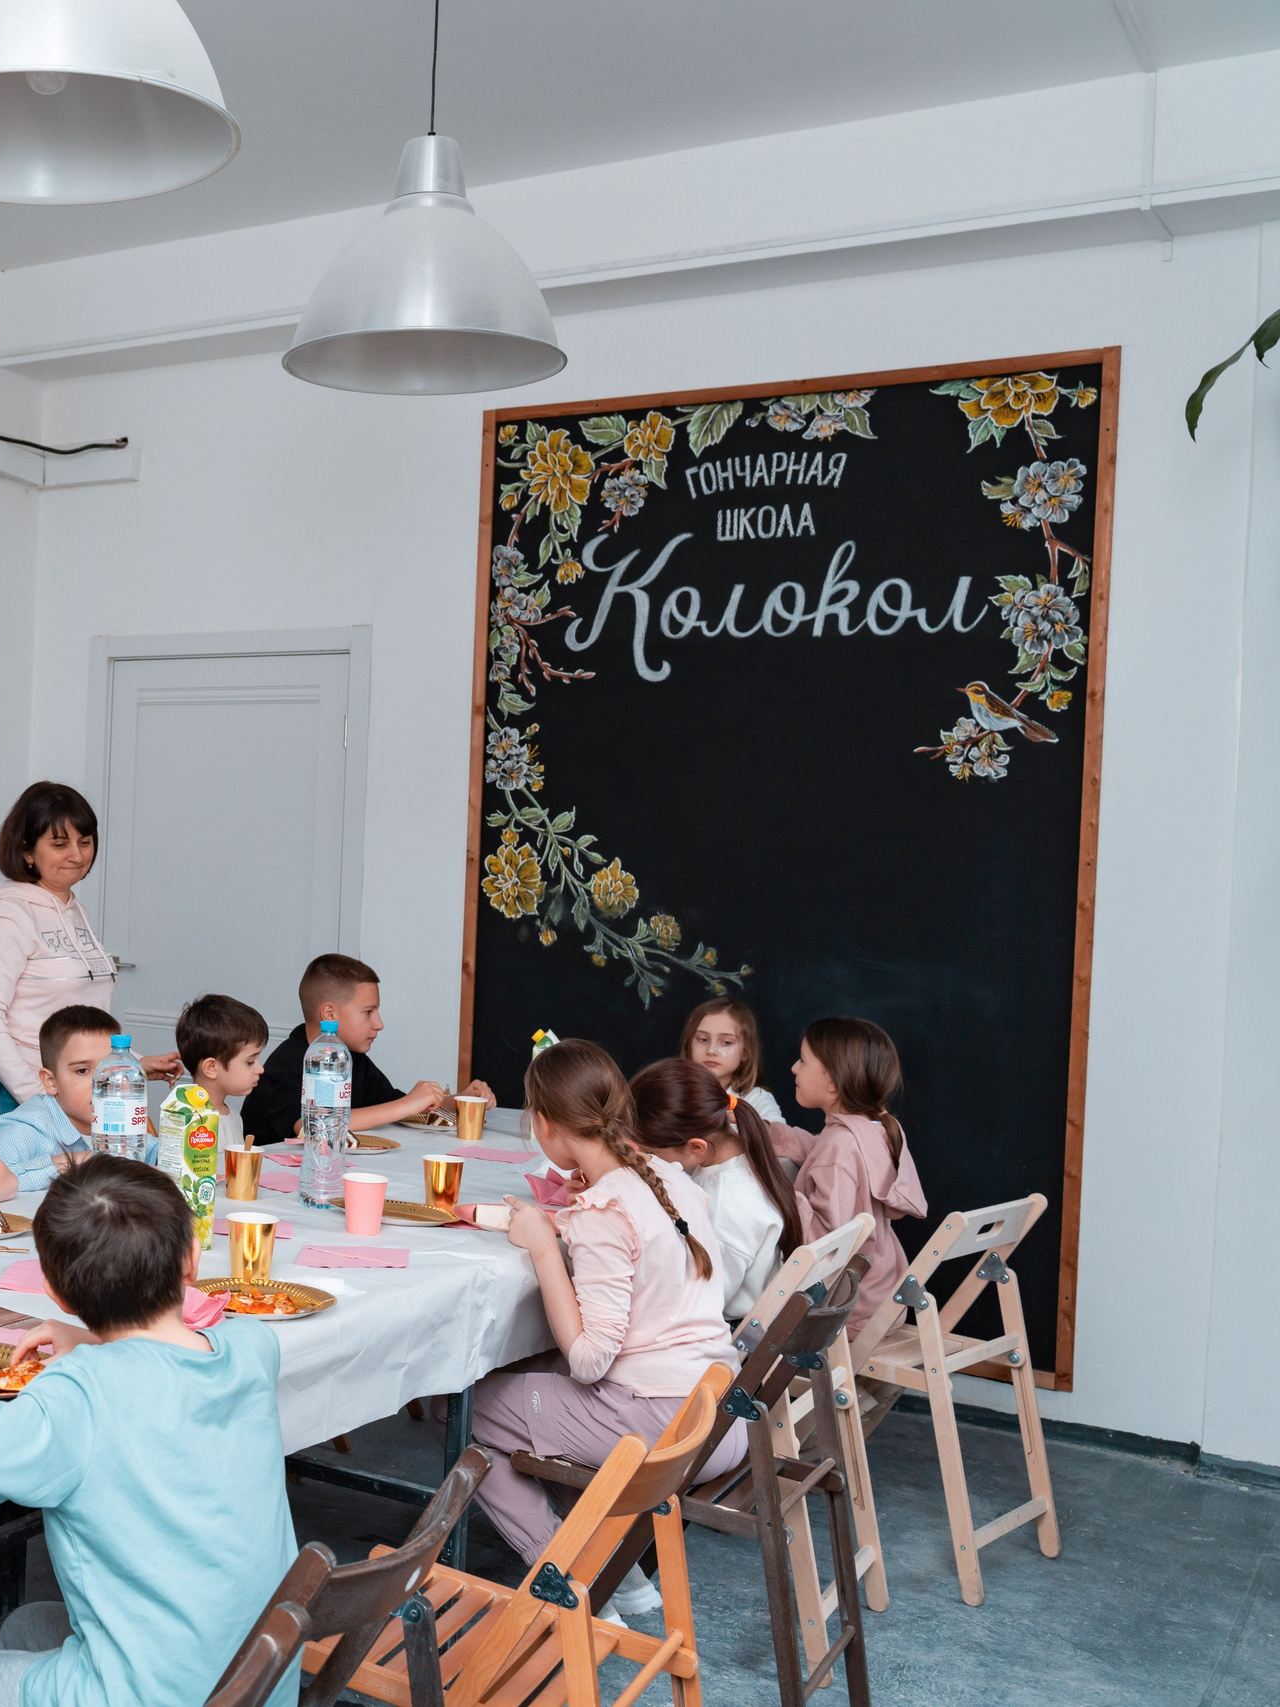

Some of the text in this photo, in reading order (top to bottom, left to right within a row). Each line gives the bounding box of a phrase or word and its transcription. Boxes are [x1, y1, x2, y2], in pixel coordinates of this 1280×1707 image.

[684, 450, 848, 500] ГОНЧАРНАЯ
[716, 502, 817, 542] ШКОЛА
[564, 530, 990, 684] Колокол
